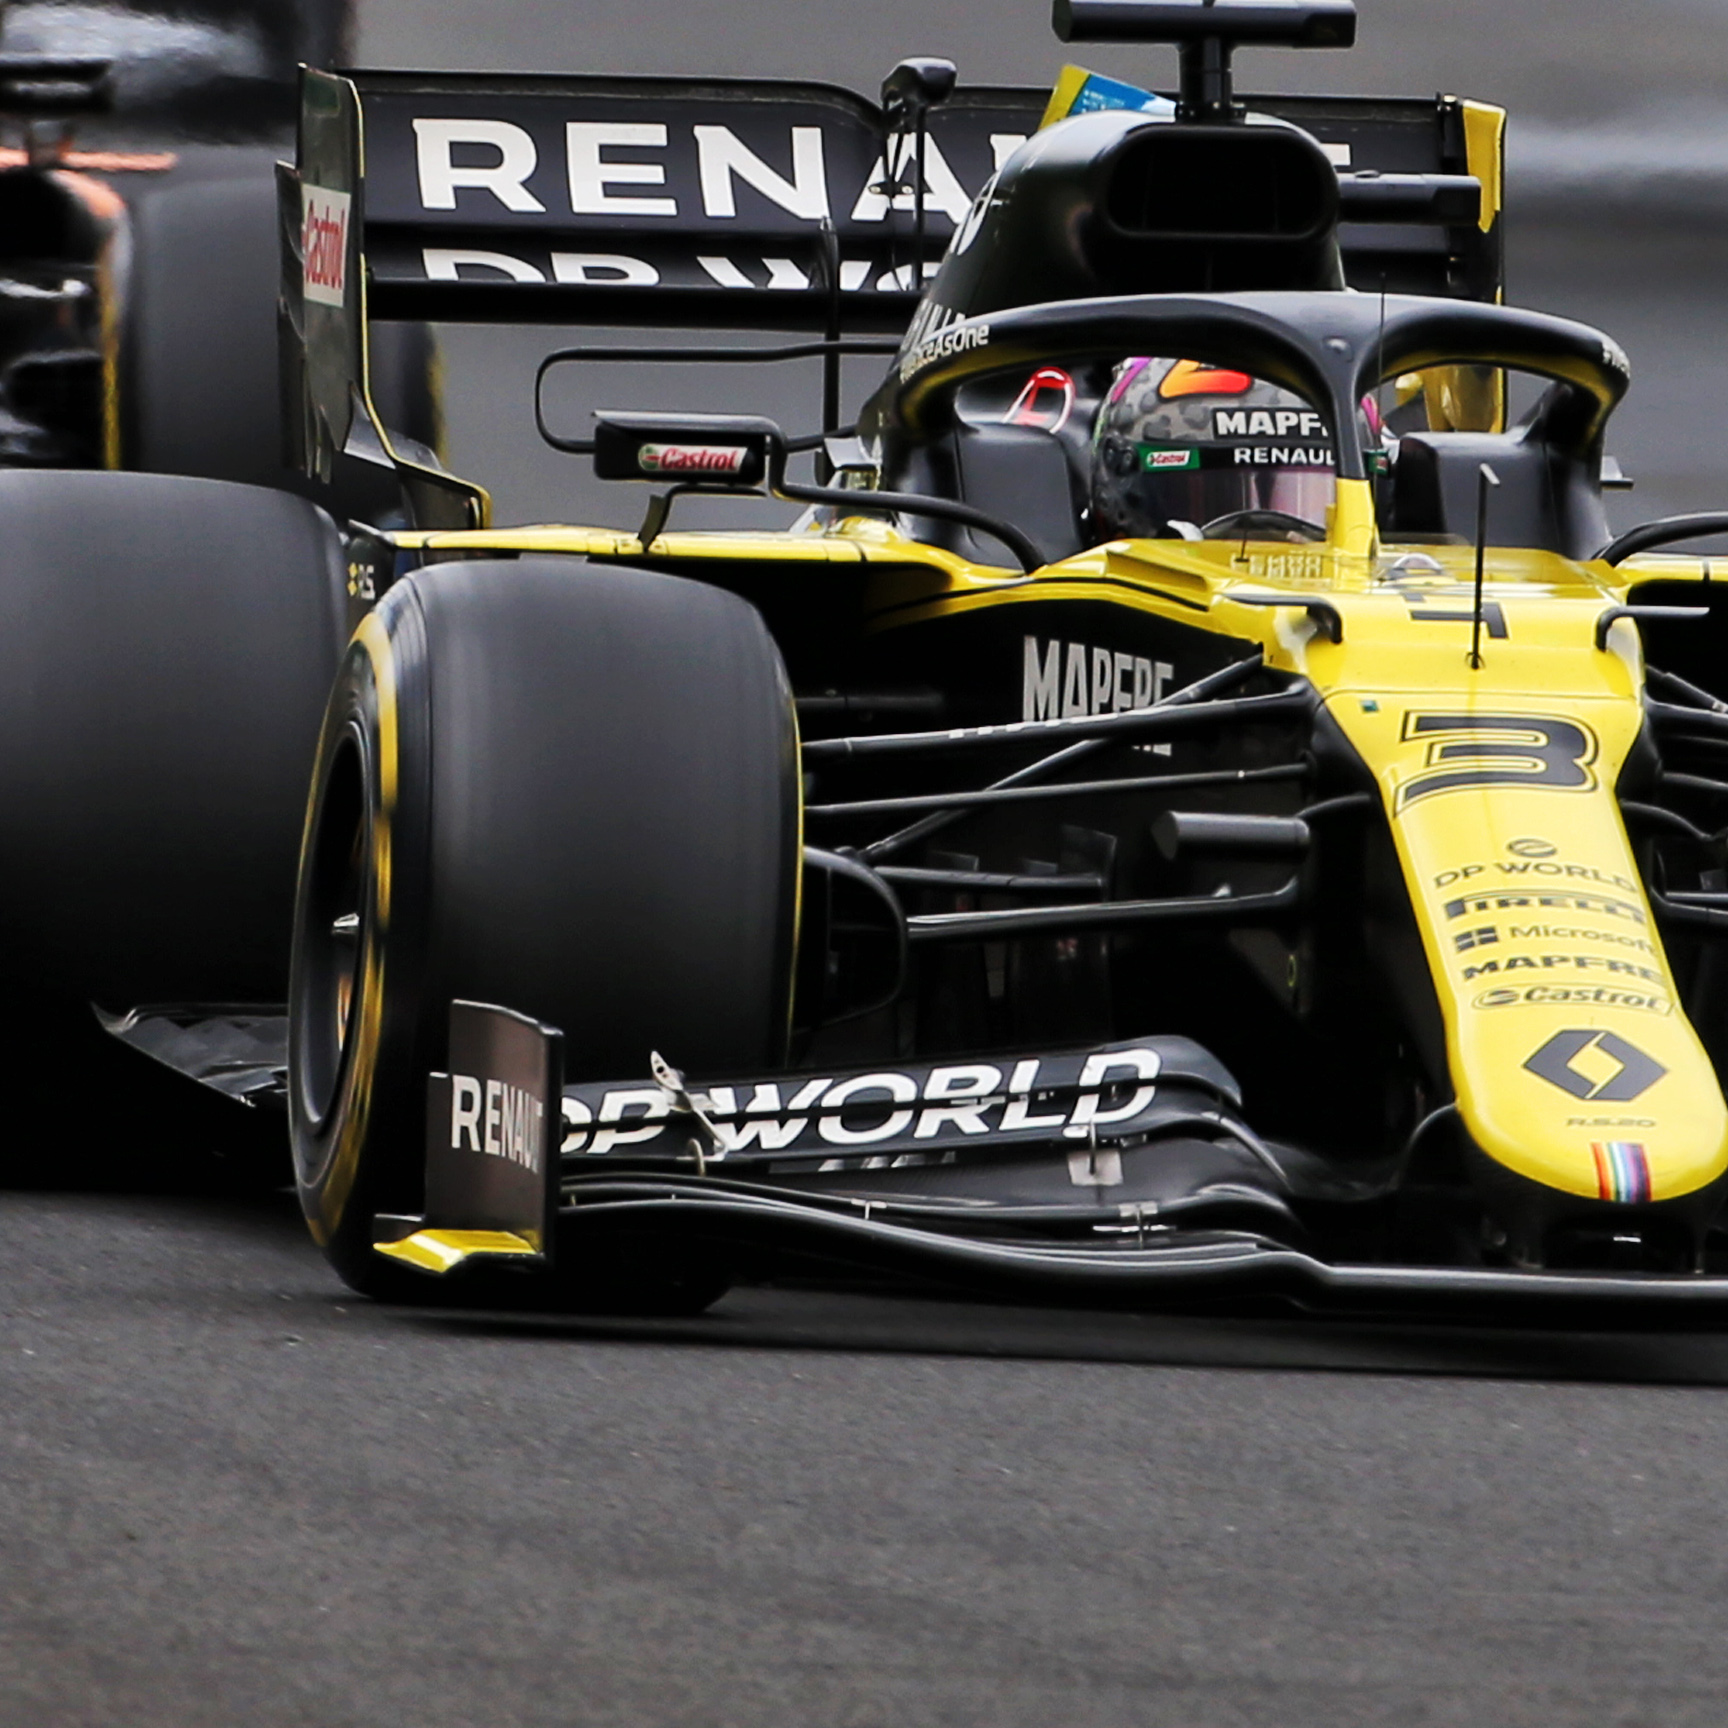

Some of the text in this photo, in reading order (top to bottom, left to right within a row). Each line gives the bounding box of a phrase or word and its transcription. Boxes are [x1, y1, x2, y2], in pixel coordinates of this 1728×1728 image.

[412, 118, 1028, 223] RENA
[660, 447, 738, 471] Castrol
[1234, 446, 1334, 466] RENAUL
[1393, 709, 1599, 818] 3
[1434, 862, 1638, 893] DP WORLD
[1462, 955, 1667, 988] MAPFRE
[1525, 986, 1660, 1010] Castrol
[688, 1048, 1162, 1152] WORLD
